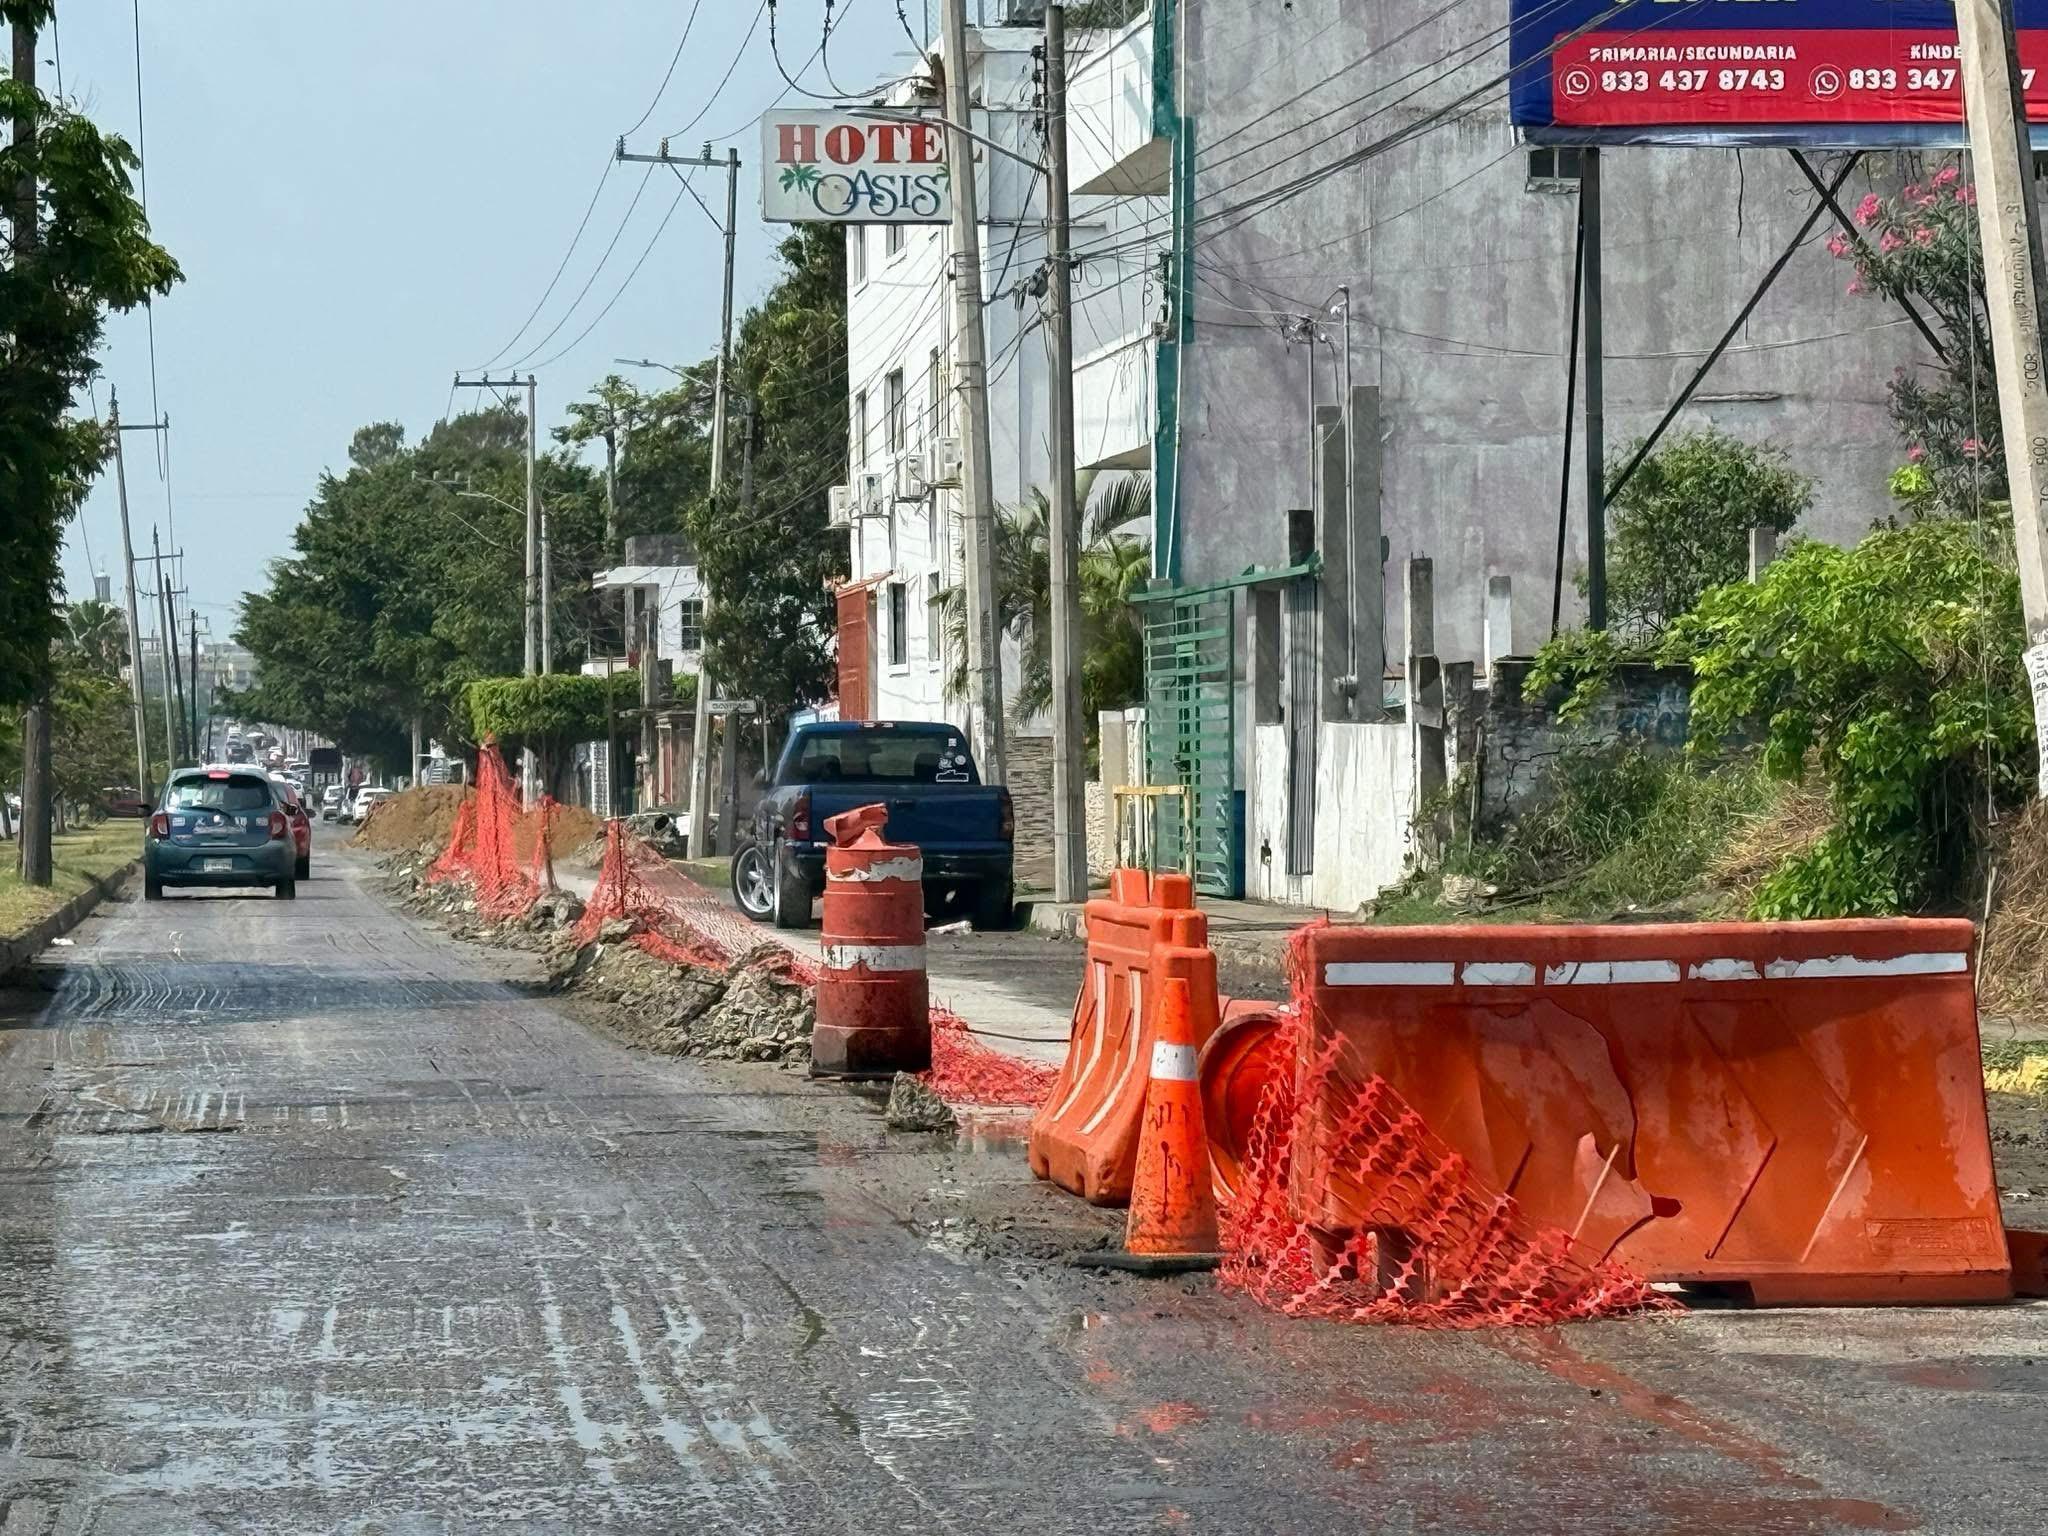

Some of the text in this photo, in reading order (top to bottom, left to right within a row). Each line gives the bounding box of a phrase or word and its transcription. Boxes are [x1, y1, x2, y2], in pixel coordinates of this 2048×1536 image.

[1602, 69, 1785, 92] 833 437 8743
[1849, 68, 1956, 90] 833 347
[812, 169, 941, 217] OASIS
